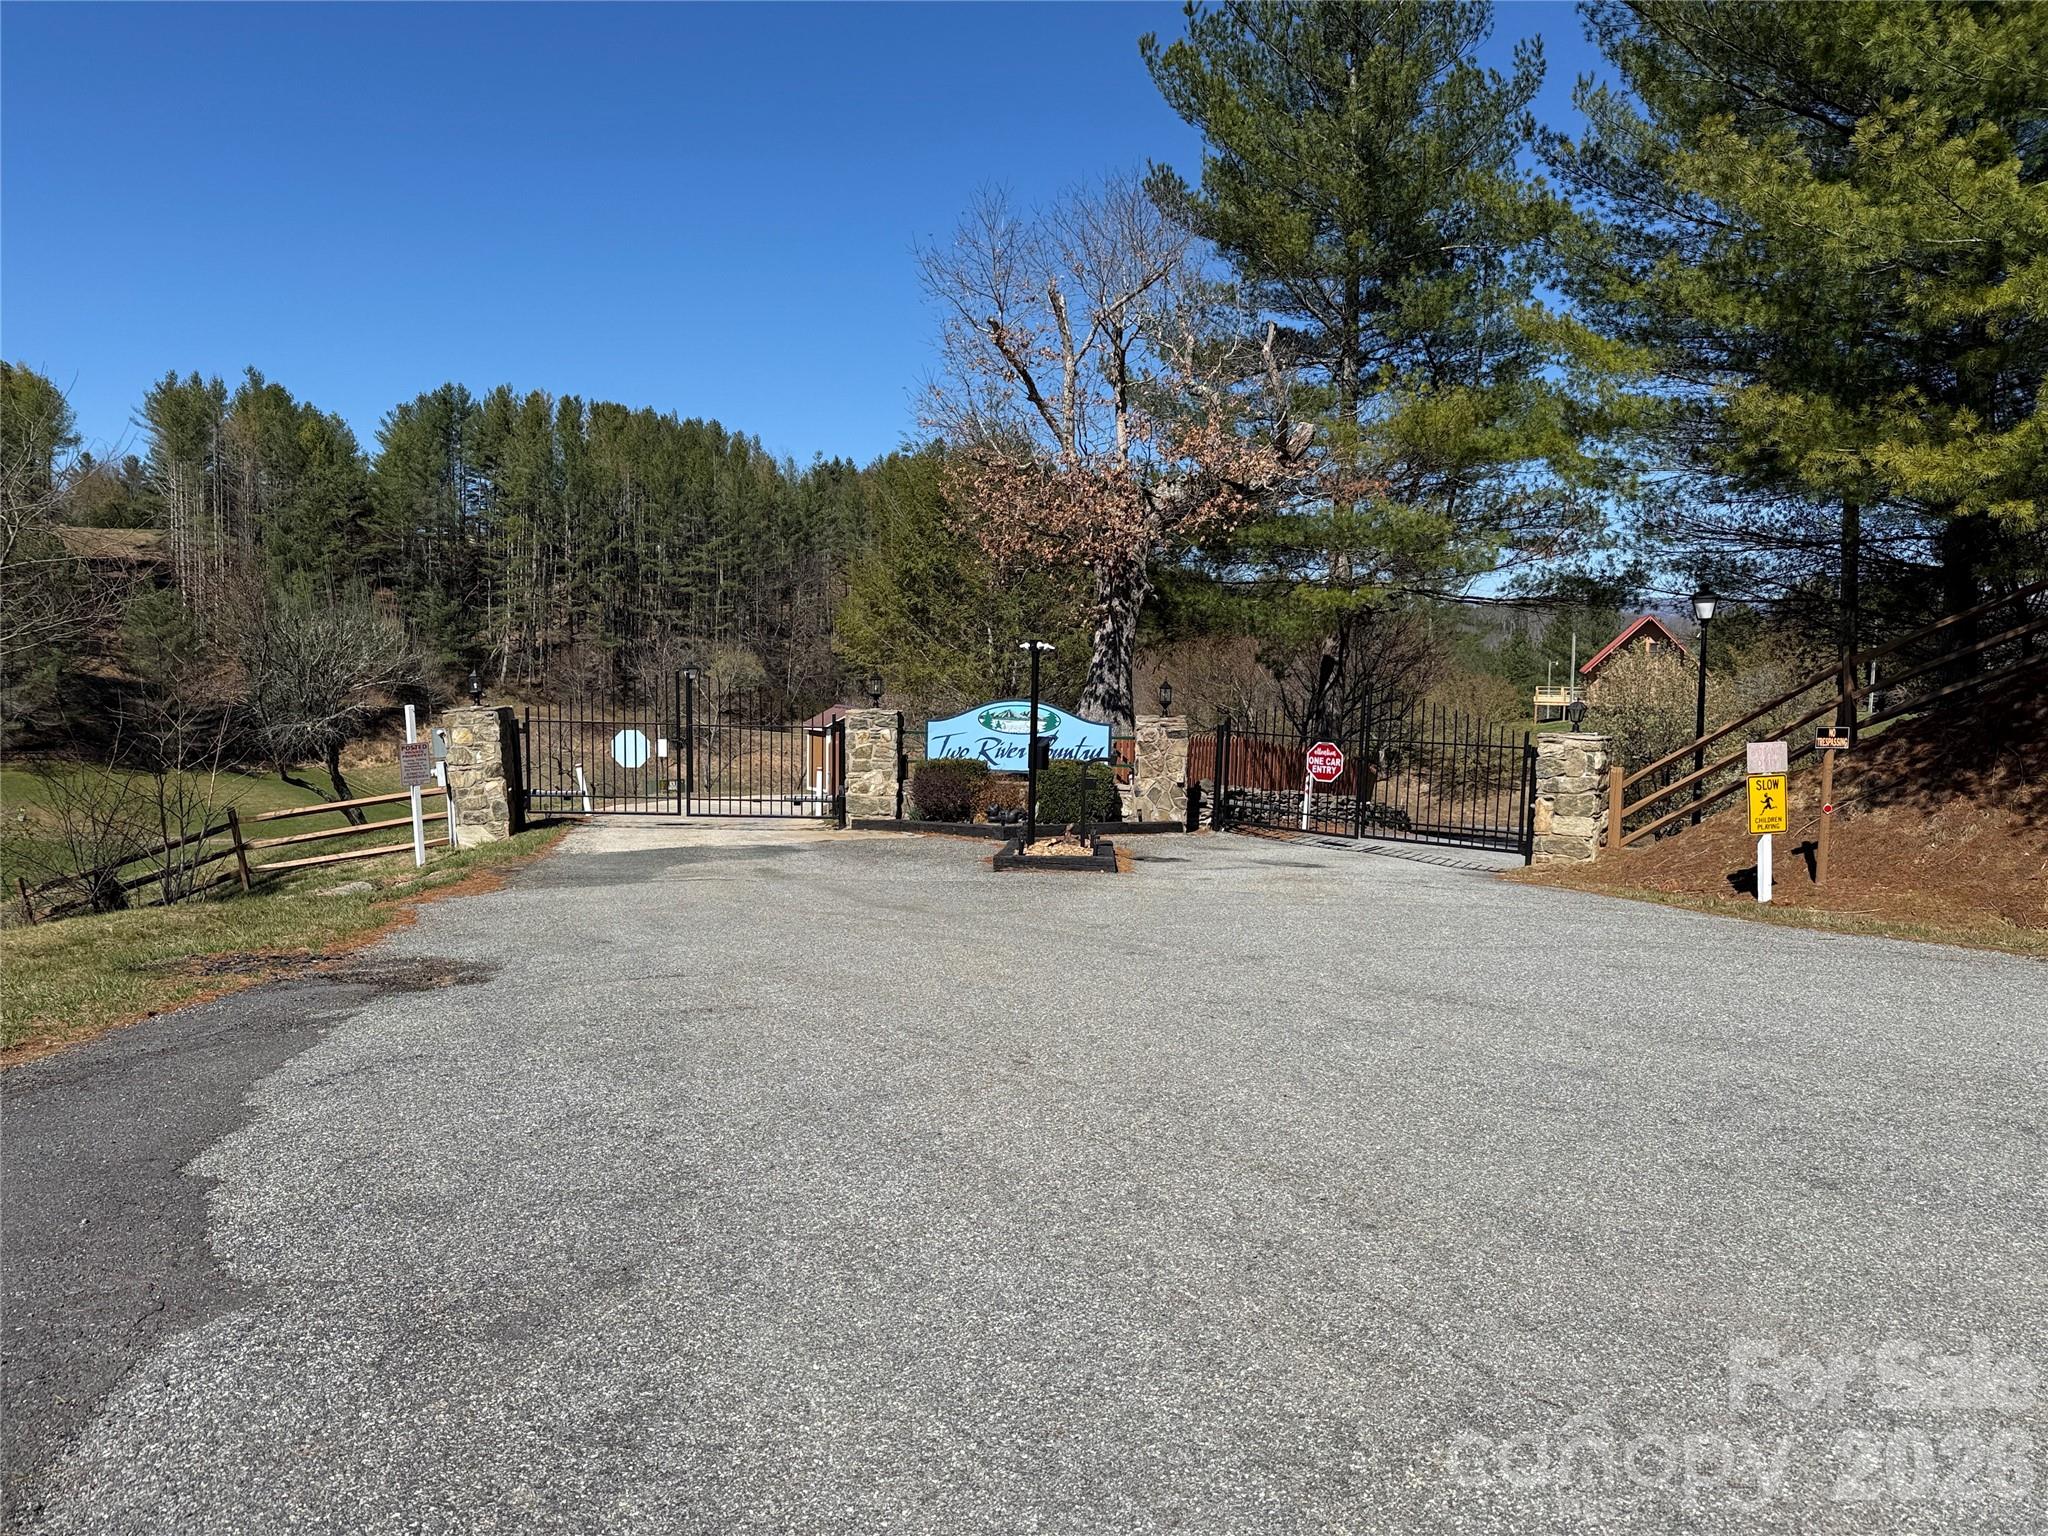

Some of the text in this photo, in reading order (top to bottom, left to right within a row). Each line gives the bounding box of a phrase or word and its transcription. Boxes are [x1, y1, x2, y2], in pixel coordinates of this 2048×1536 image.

[1829, 728, 1836, 738] NO
[931, 732, 970, 759] Two
[974, 736, 1027, 766] River
[1309, 756, 1340, 767] ONE CAR
[1312, 765, 1337, 774] ENTRY
[1756, 779, 1779, 791] SLOW
[1755, 816, 1782, 824] CHILDREN
[1757, 823, 1780, 831] PLAYING
